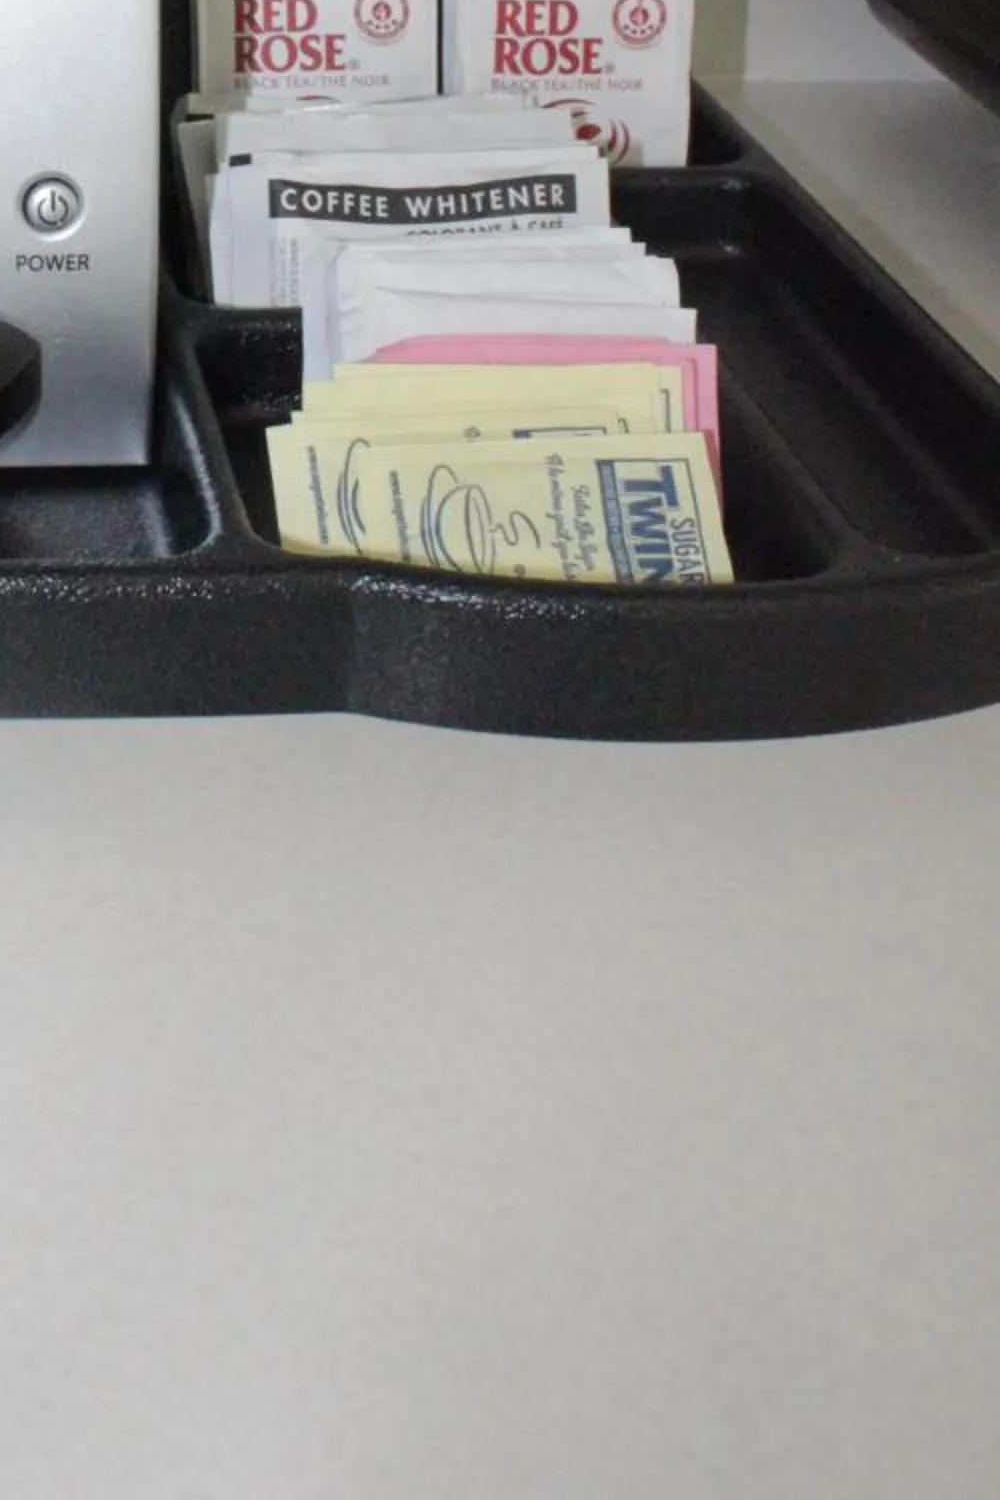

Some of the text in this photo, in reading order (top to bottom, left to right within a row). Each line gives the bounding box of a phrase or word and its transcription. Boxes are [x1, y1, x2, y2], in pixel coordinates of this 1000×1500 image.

[233, 75, 277, 89] BLACK
[491, 78, 538, 92] BLACK
[280, 182, 566, 218] COFFEE WHITENER
[16, 253, 90, 272] POWER
[624, 465, 679, 585] TWIN
[670, 517, 705, 585] SUGAR
